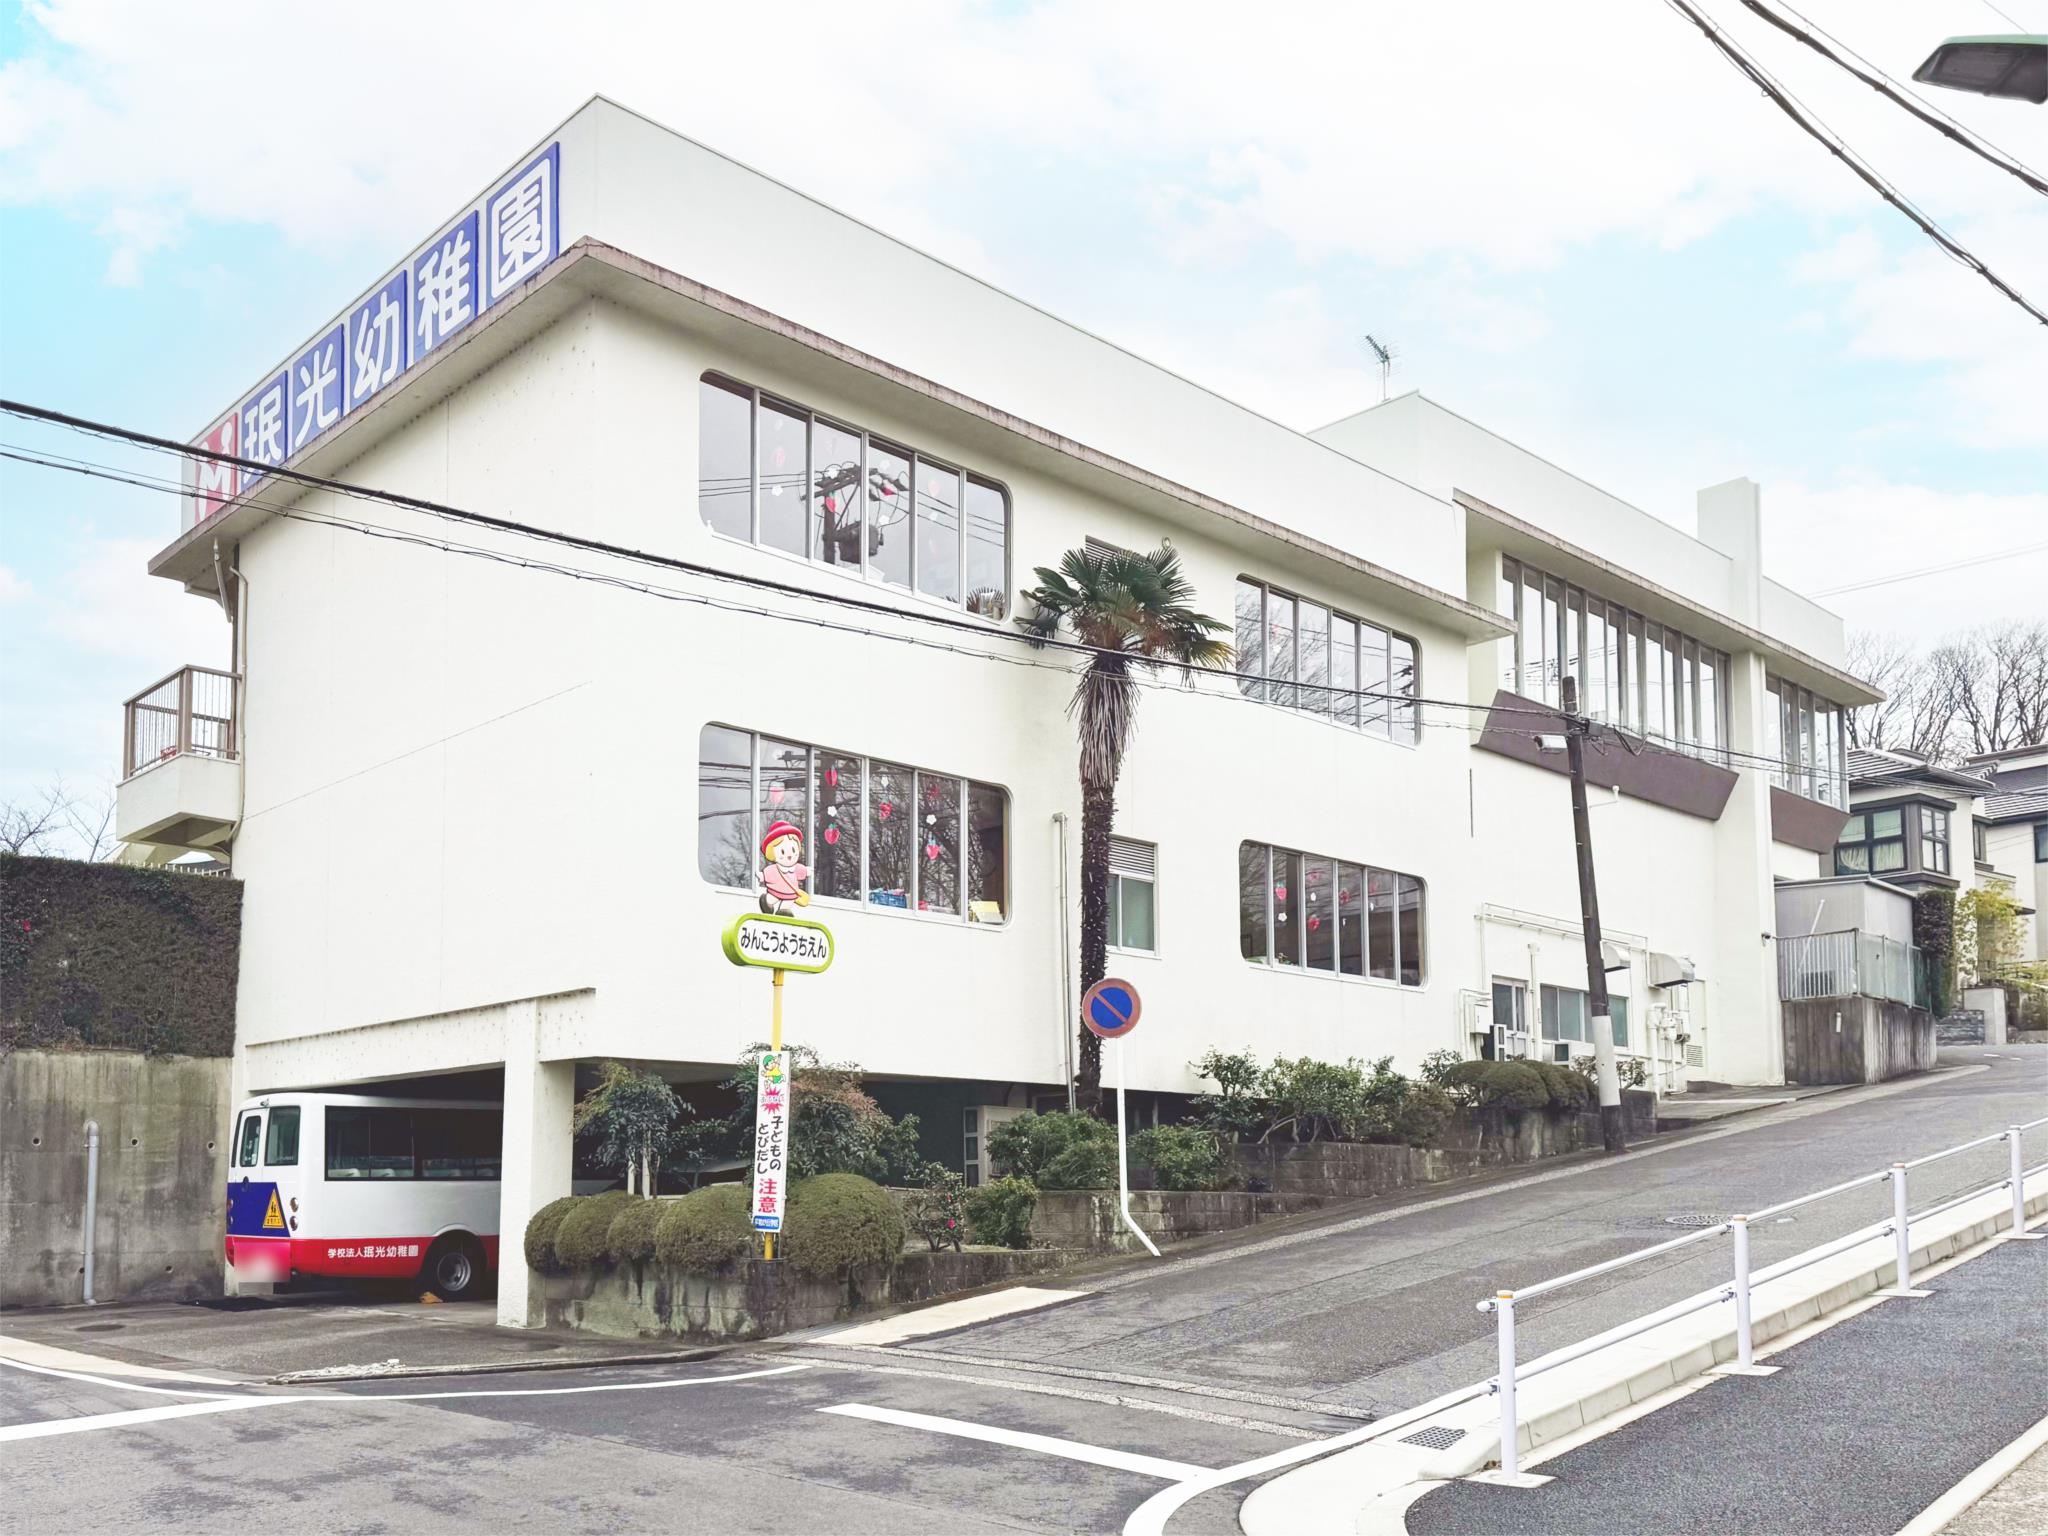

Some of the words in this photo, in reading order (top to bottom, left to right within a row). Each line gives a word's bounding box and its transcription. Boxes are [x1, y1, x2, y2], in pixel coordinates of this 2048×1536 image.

[244, 158, 551, 484] 珉光幼稚園
[740, 927, 827, 959] みんこうようちえん
[756, 1122, 770, 1175] とびだし
[769, 1115, 784, 1171] 子どもの
[758, 1178, 777, 1213] 注意
[327, 1244, 419, 1259] 学校法人珉光幼稚園
